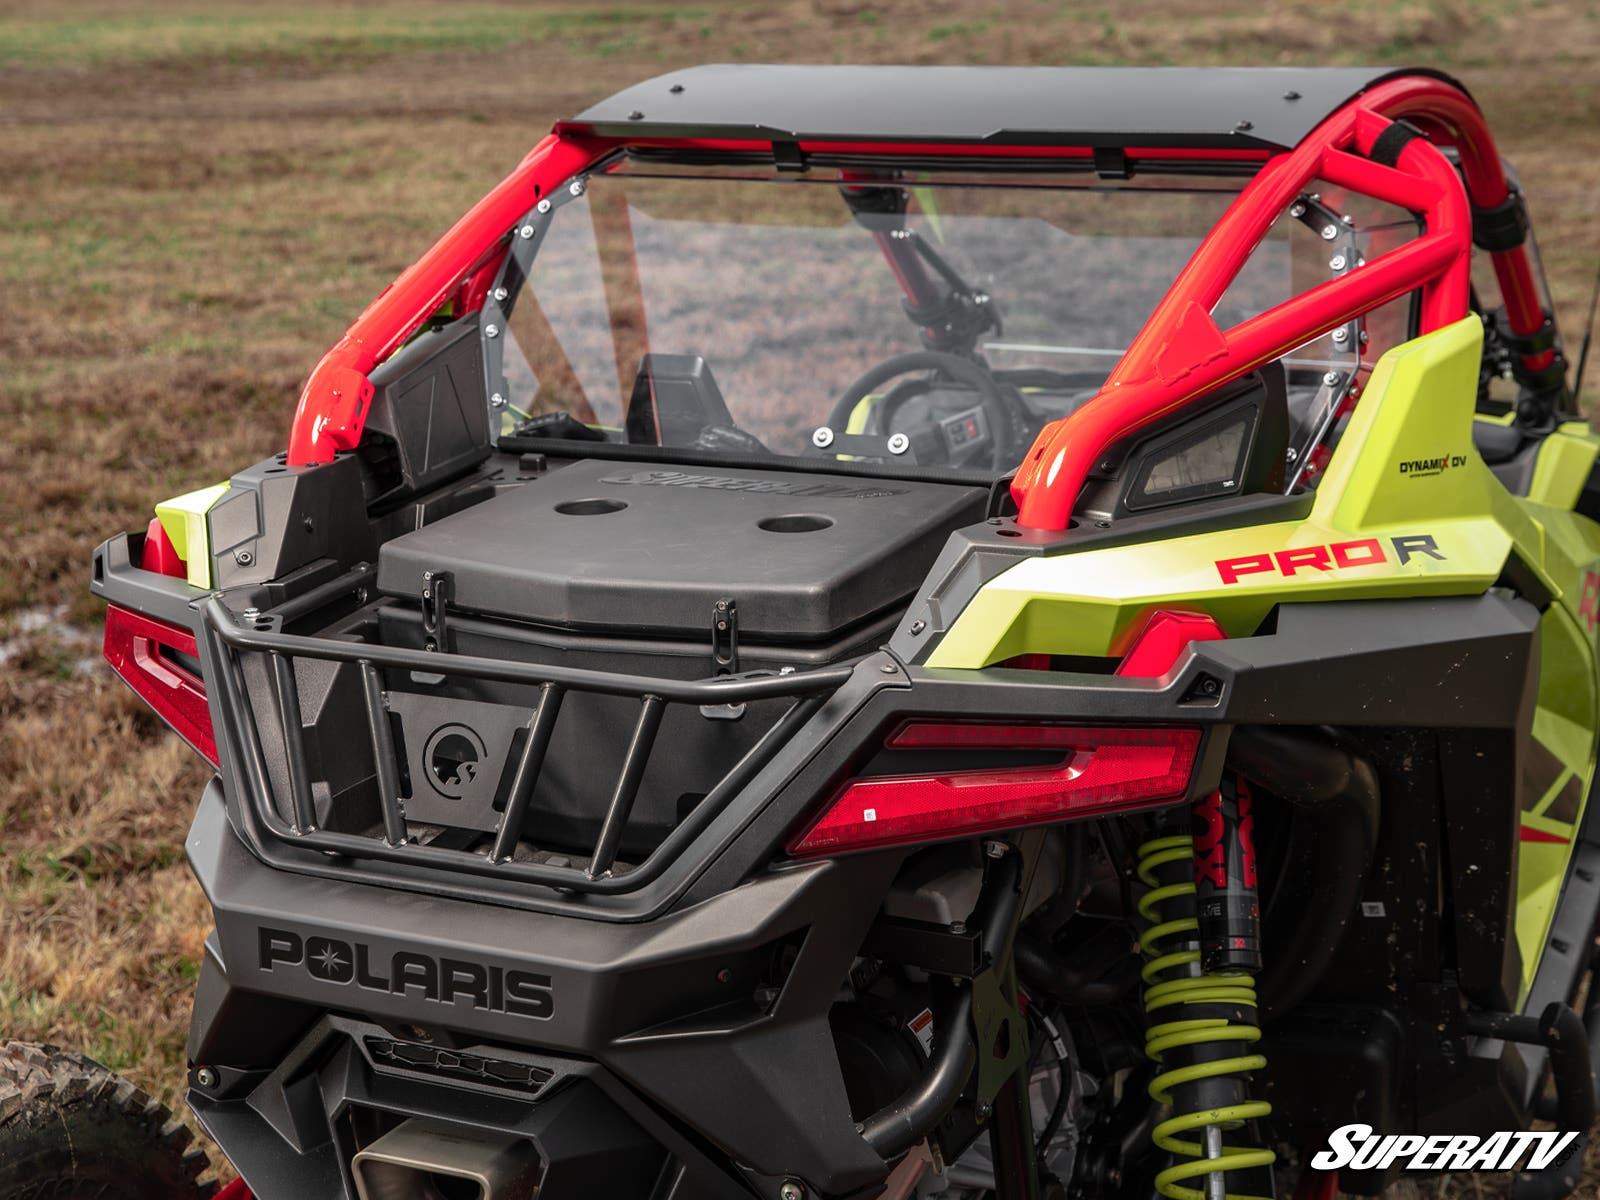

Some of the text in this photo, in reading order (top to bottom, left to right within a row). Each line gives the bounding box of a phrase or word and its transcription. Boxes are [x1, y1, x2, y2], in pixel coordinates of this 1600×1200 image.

[1399, 453, 1467, 474] DYNAMIX DV
[1215, 535, 1448, 584] PRO R
[258, 927, 556, 1021] POLARIS
